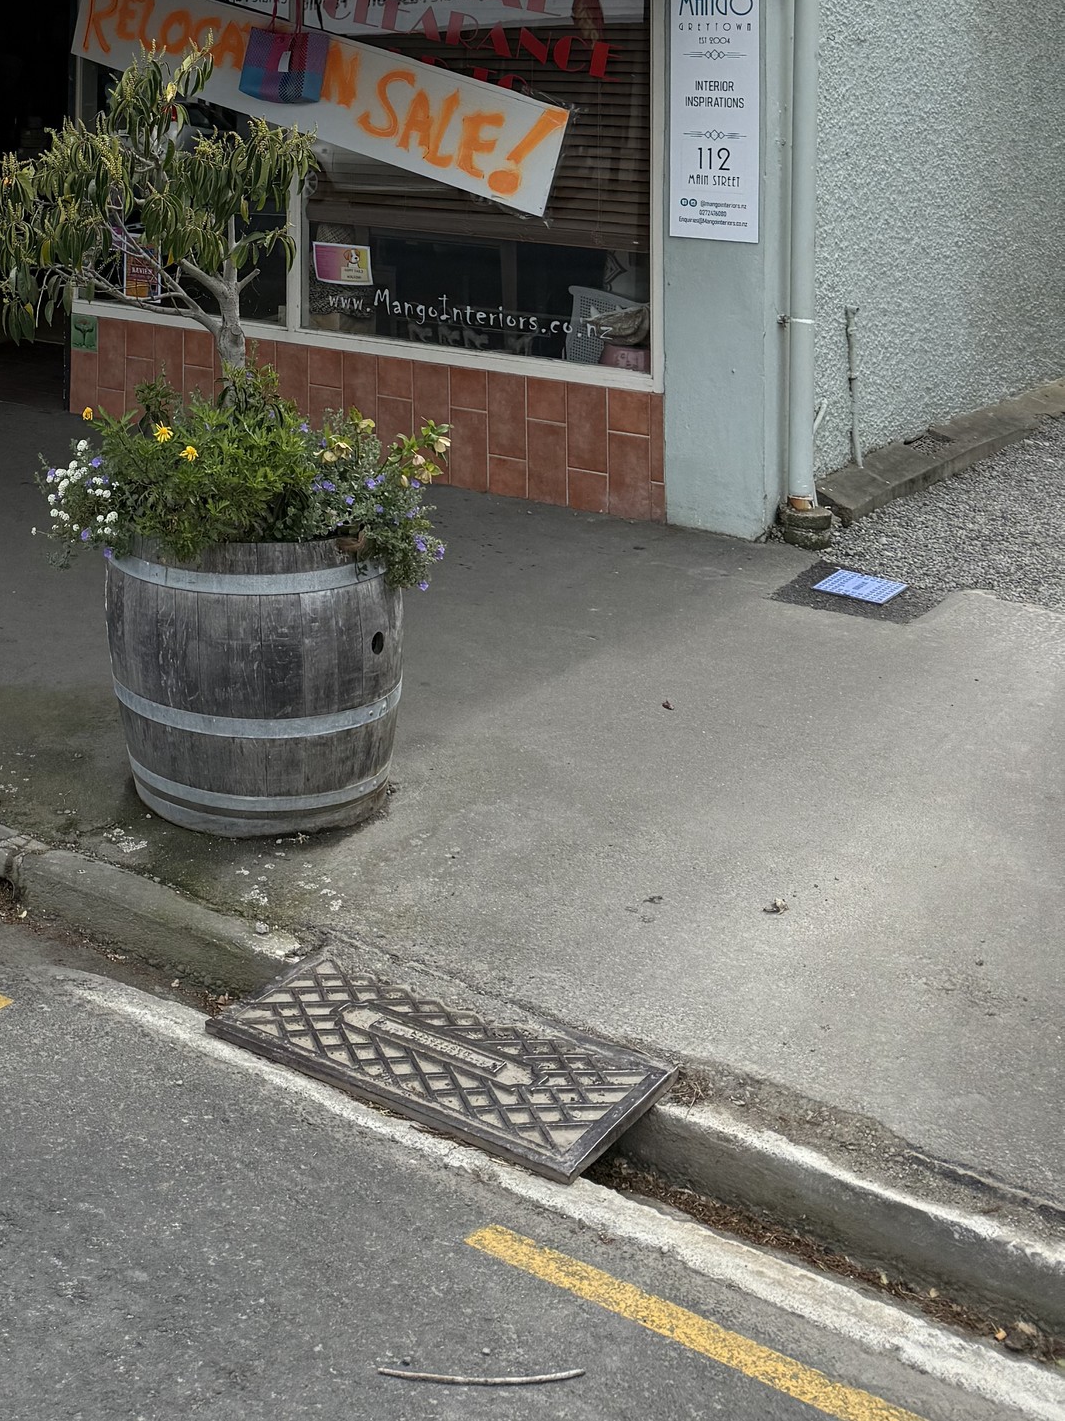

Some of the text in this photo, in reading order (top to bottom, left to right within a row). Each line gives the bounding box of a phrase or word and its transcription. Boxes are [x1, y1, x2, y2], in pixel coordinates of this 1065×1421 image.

[678, 22, 752, 32] GREYTOWN
[694, 80, 735, 92] INTERIOR
[685, 96, 745, 109] INSPIRATIONS
[358, 69, 571, 197] SALE!
[697, 147, 731, 171] 112
[688, 174, 741, 188] MAIN STREET
